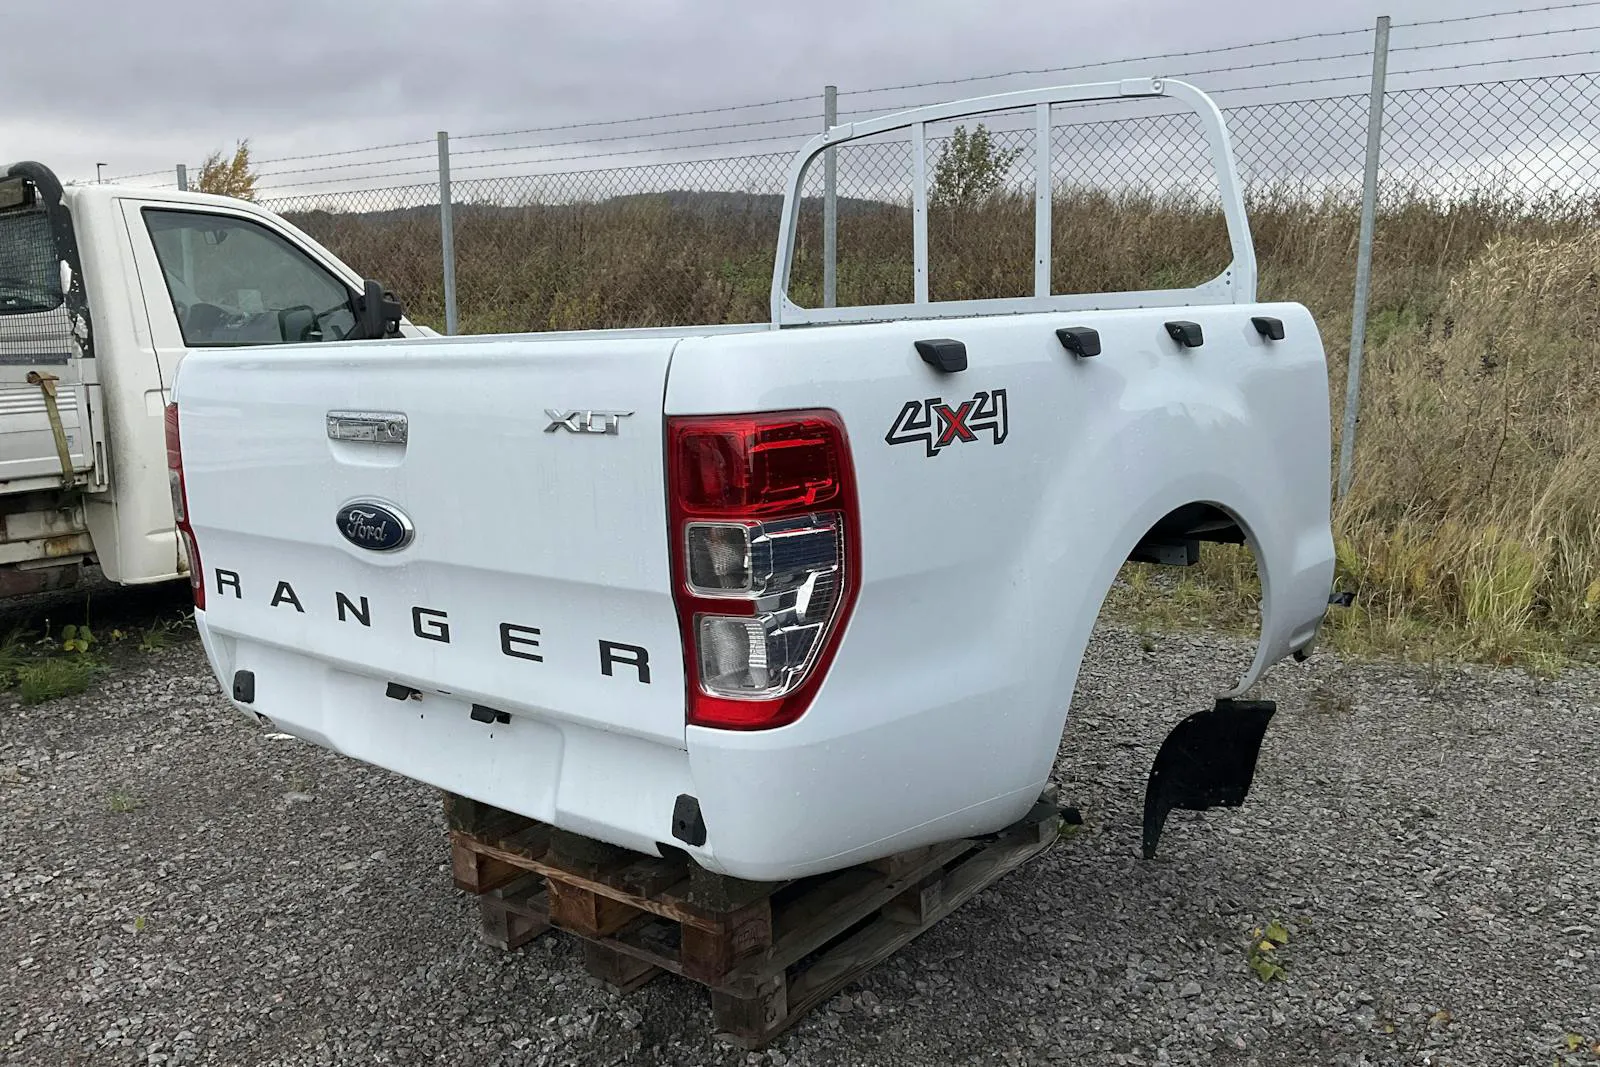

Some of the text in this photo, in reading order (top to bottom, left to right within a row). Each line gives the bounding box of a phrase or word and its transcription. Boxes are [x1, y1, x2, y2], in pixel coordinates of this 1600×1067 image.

[543, 408, 635, 436] XLT
[346, 509, 388, 541] Ford
[215, 568, 651, 684] RANGER
